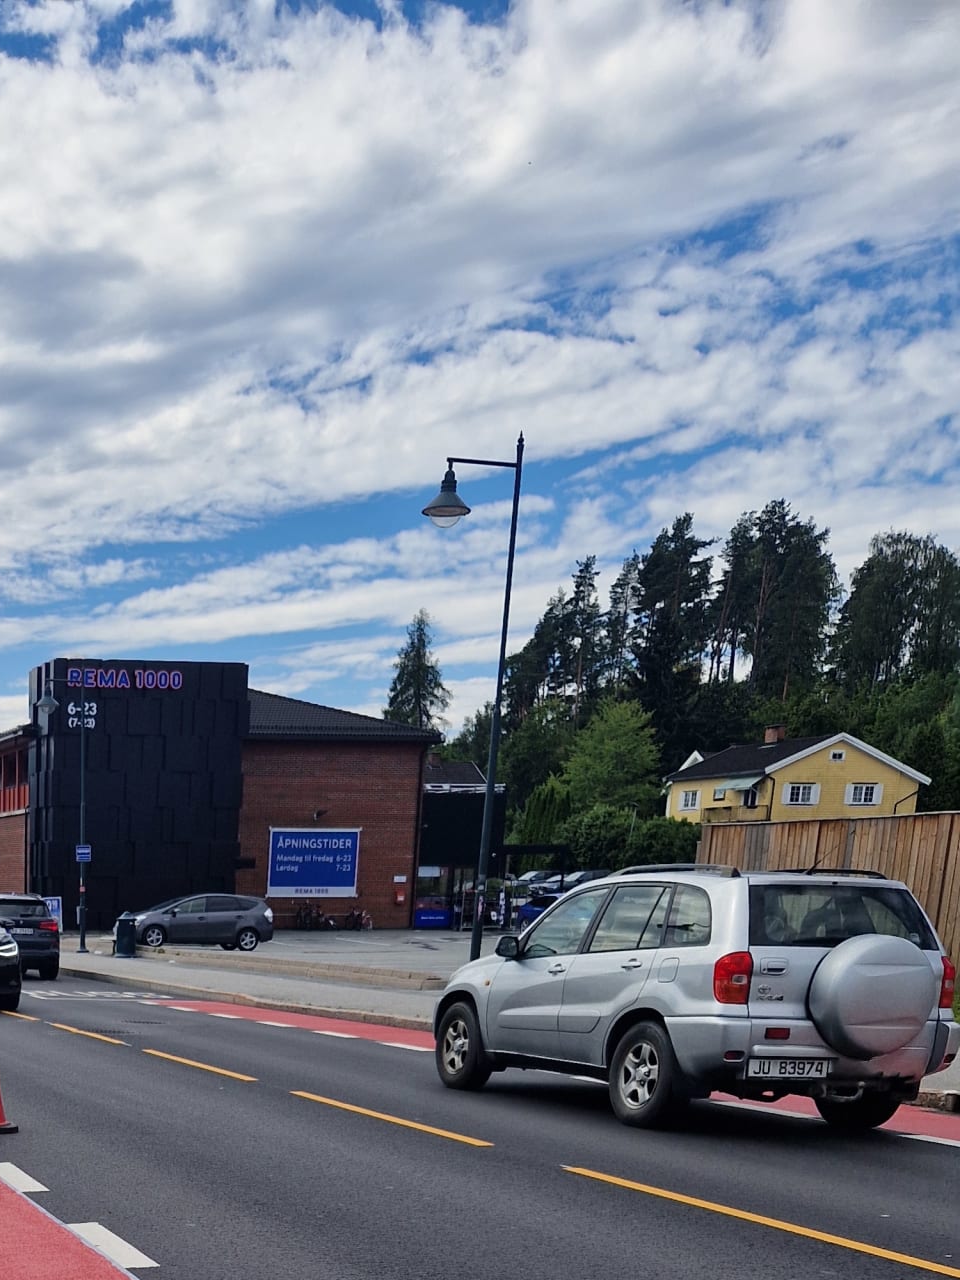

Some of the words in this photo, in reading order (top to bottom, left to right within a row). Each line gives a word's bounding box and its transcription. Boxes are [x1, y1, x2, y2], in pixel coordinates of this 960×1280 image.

[67, 668, 130, 689] REMA
[135, 669, 183, 690] 1000
[67, 702, 97, 716] 6-23
[276, 836, 352, 849] ÅPNINGSTIDER
[276, 854, 303, 863] Mandag
[313, 854, 334, 863] fredag
[276, 864, 299, 872] Lørdag
[336, 864, 351, 872] 7-23
[753, 1061, 771, 1075] JU
[778, 1061, 824, 1076] 83974
